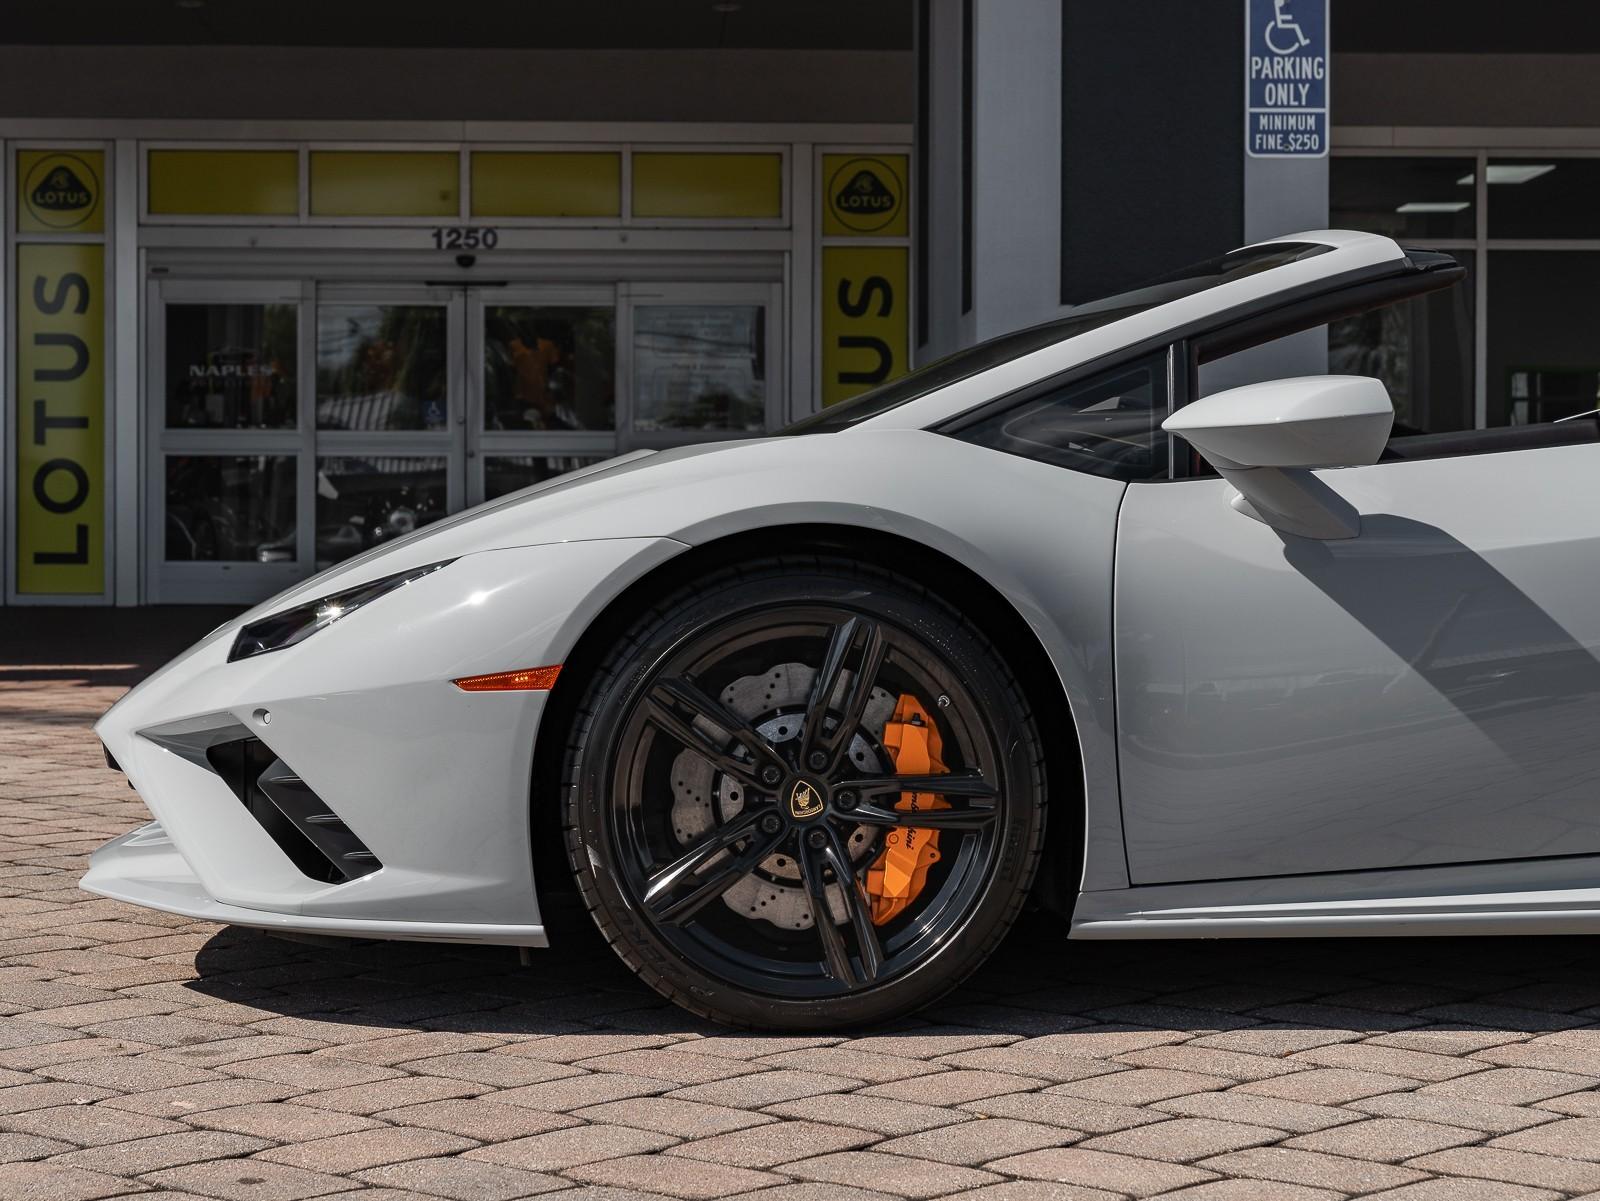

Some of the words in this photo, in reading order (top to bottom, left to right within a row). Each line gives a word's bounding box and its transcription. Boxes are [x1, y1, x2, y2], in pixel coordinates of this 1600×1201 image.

[1251, 56, 1324, 80] PARKING
[1264, 83, 1310, 106] ONLY
[1259, 114, 1316, 131] MINIMUM
[1255, 134, 1284, 150] FINE
[1288, 133, 1319, 151] $250
[36, 191, 88, 204] LOTUS
[841, 195, 891, 207] LOTUS
[432, 226, 498, 250] 1250
[190, 365, 273, 377] NAPLES
[33, 272, 90, 565] LOTUS
